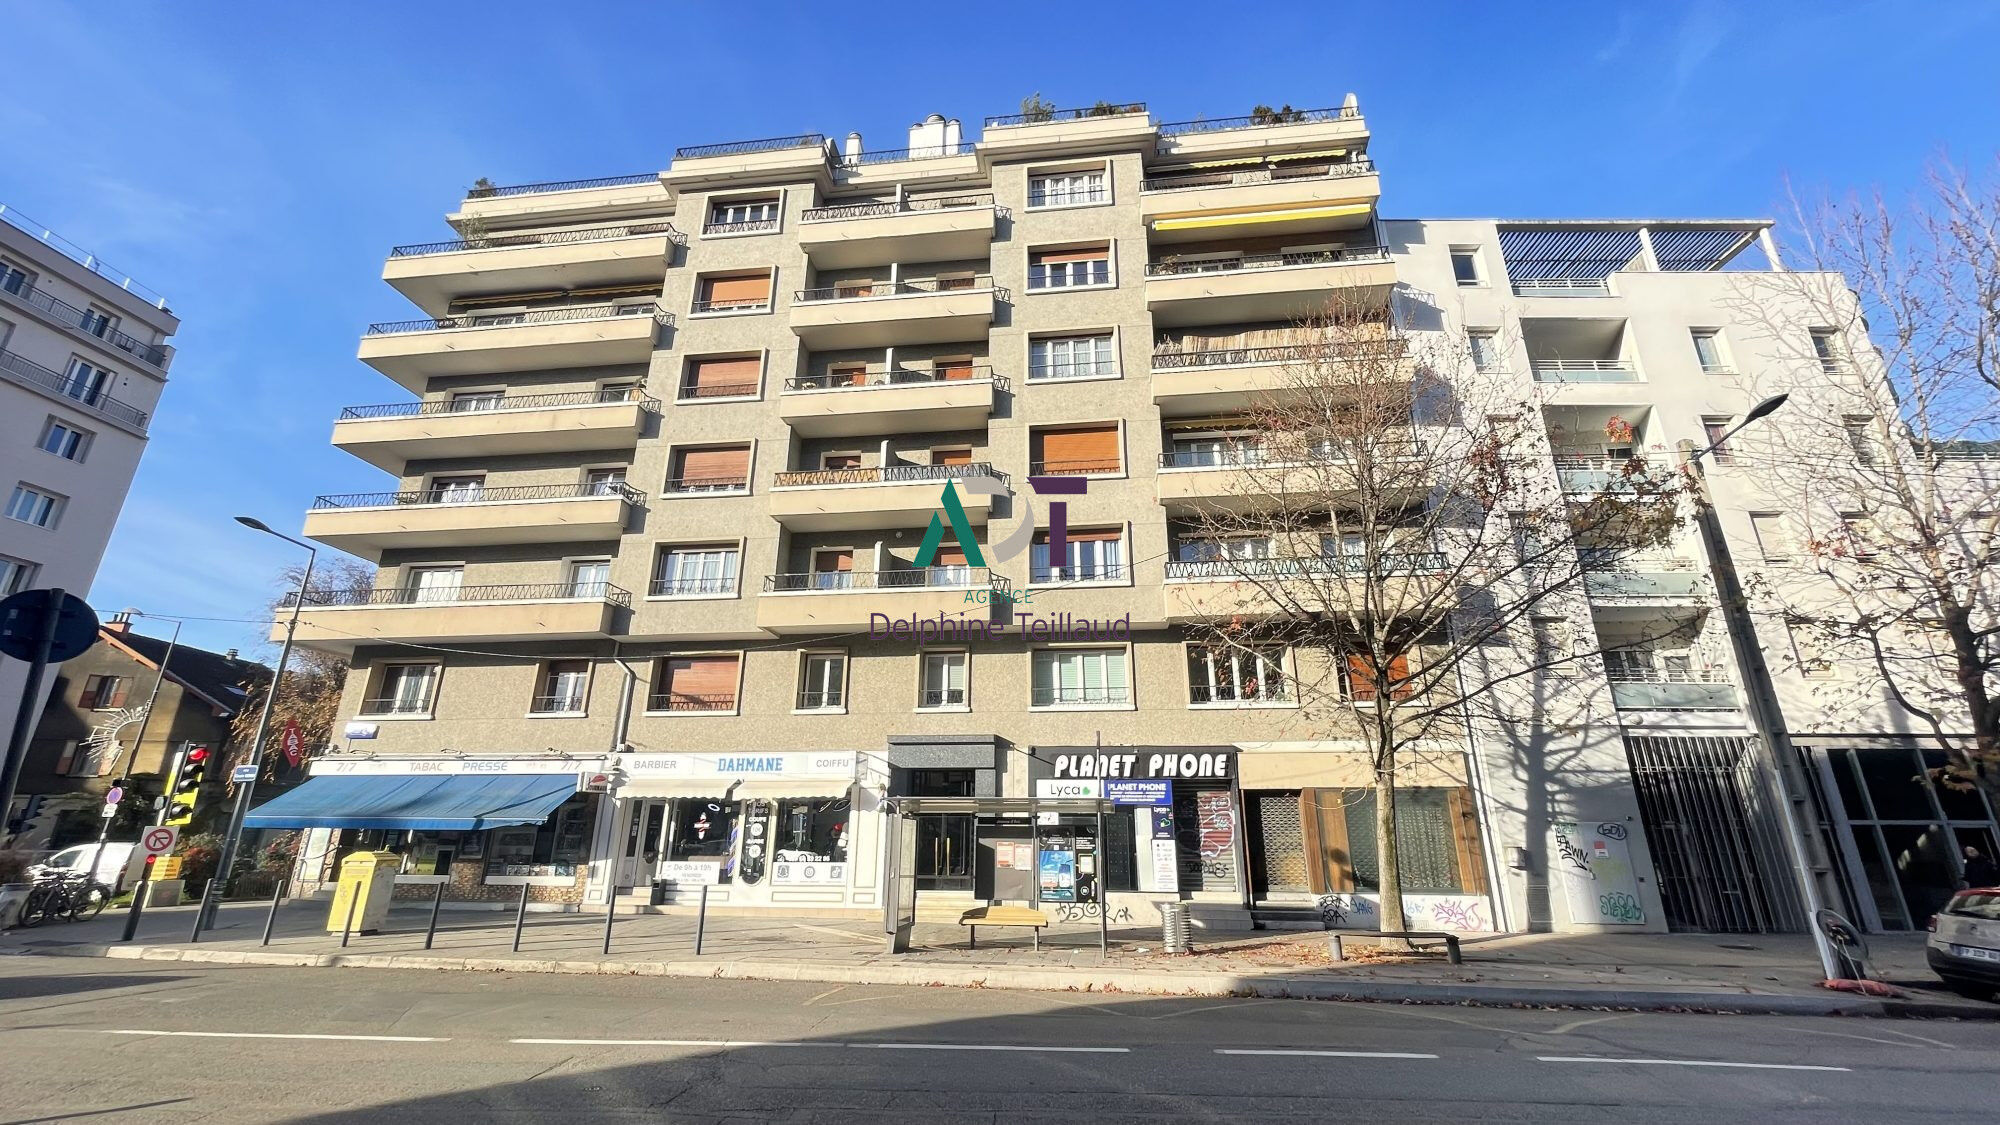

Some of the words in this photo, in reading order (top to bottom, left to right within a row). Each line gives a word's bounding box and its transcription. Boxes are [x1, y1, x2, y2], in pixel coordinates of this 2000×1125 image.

[287, 728, 299, 756] TABAC
[409, 762, 445, 772] TABAC
[462, 761, 508, 771] PRESSE
[633, 760, 677, 769] BARBIER
[717, 757, 783, 772] DAHMANE
[816, 759, 849, 768] COIFFU
[1054, 754, 1138, 778] PLANET
[1149, 753, 1228, 778] PHONE
[1050, 783, 1080, 797] Lyca
